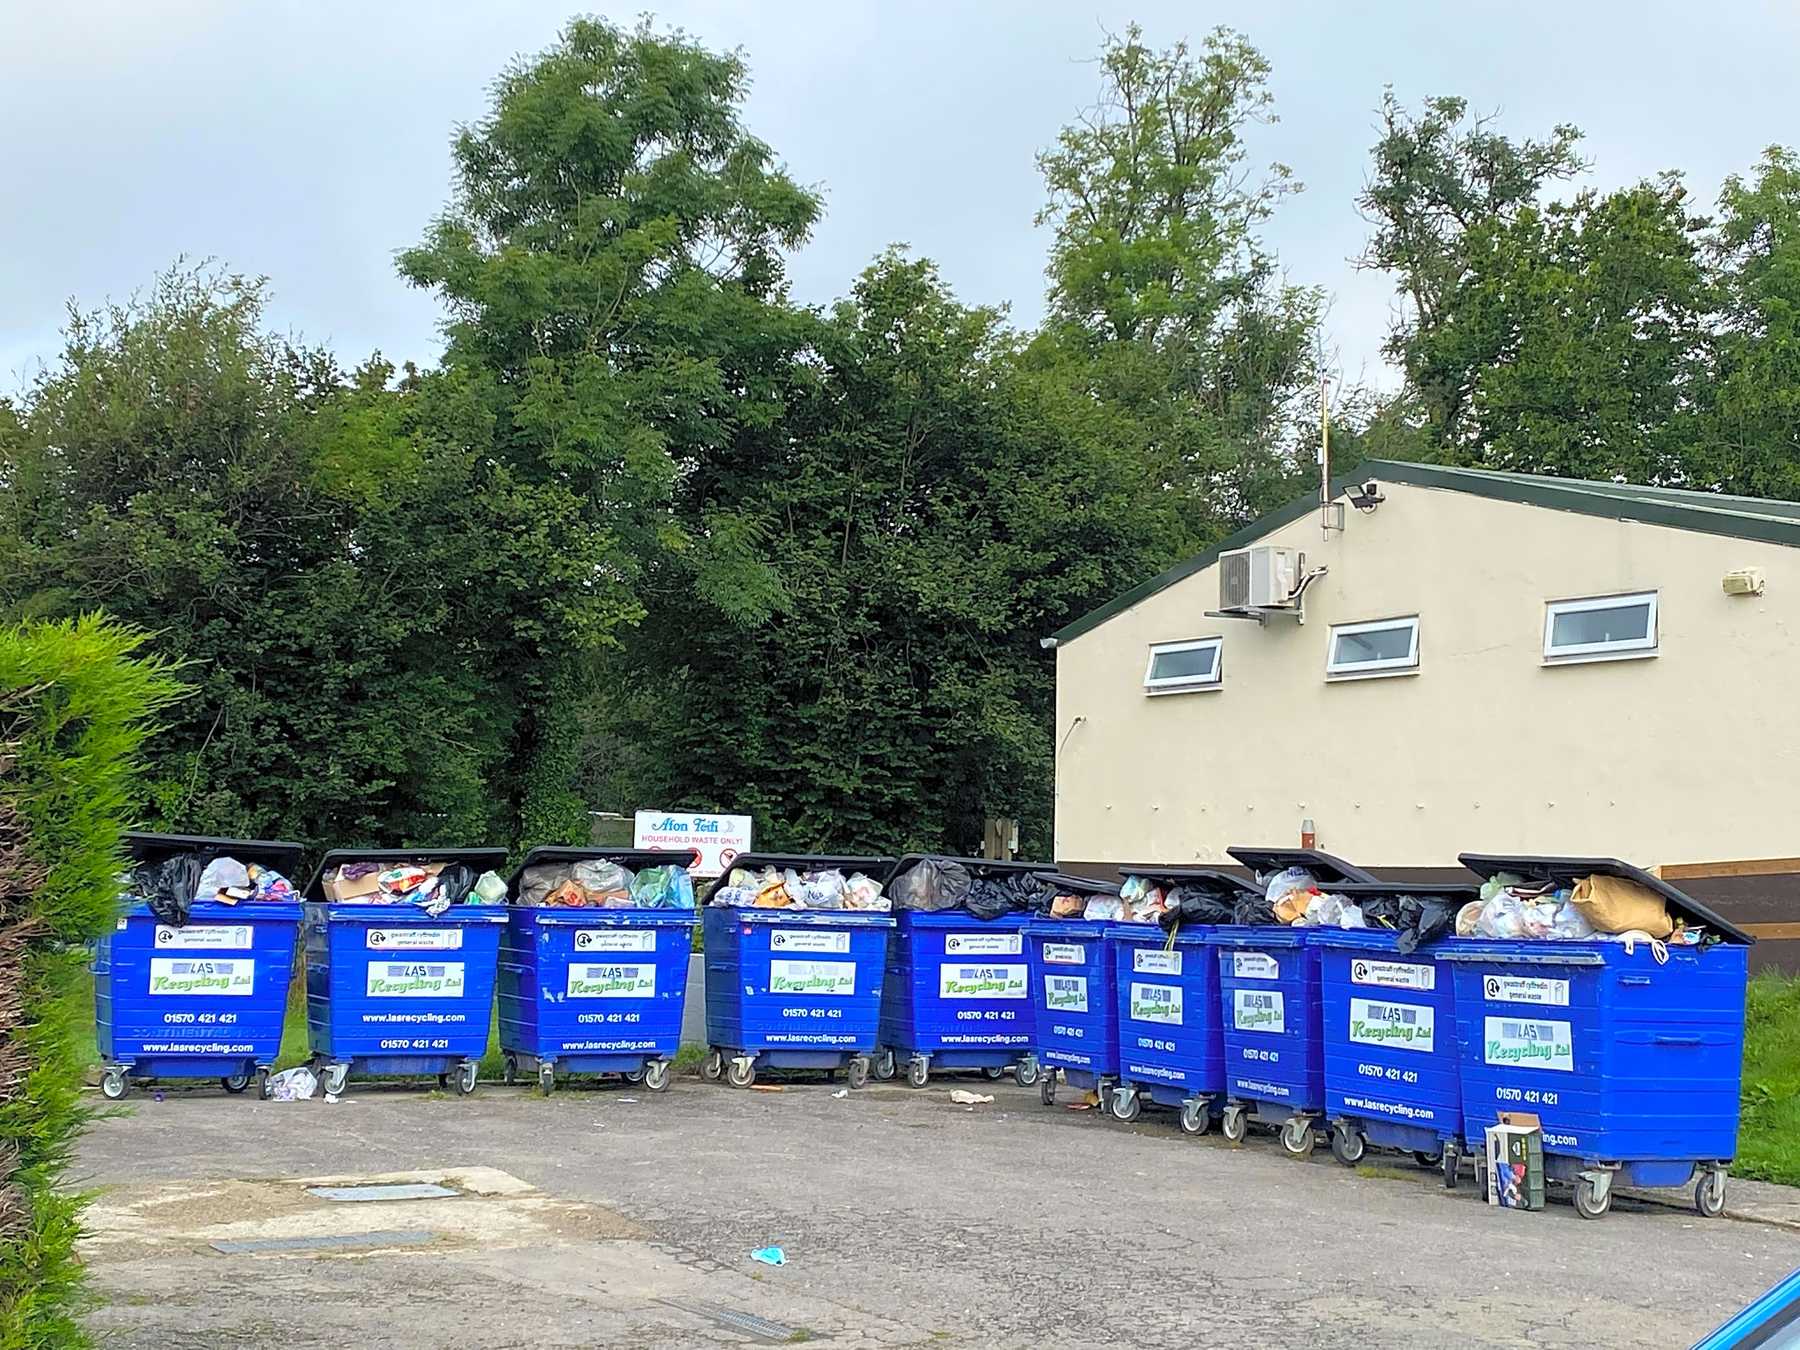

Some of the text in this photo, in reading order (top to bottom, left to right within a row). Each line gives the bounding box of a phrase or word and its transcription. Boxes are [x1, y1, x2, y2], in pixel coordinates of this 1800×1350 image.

[651, 817, 718, 833] Afon Teifi
[642, 835, 743, 845] HOUSEHOLD WASTE ONLY!
[190, 963, 214, 973] LAS
[404, 966, 427, 977] LAS
[602, 968, 622, 978] LAS
[974, 969, 993, 978] LAS
[153, 976, 250, 991] Recycling Ltd
[370, 978, 461, 993] Recycling Ltd
[570, 979, 653, 994] Recycling Ltd
[945, 980, 1006, 994] Recycling
[1008, 980, 1022, 988] Ltd
[164, 1014, 237, 1023] 01570 421 421
[363, 1013, 465, 1023] www.lasrecycling.com
[578, 1014, 640, 1023] 01570 421 421
[783, 1009, 842, 1018] 01570 421 421
[957, 1011, 1015, 1019] 01570 421 421
[1383, 1006, 1401, 1022] LAS
[1352, 1021, 1431, 1041] Recycling Ltd
[1518, 1023, 1537, 1040] LAS
[381, 1040, 448, 1048] 01570 421 421
[766, 1034, 856, 1044] www.lasrecycling.com
[941, 1035, 1028, 1044] www.lasrecycling.com
[143, 1043, 254, 1053] www.lasrecycling.com
[563, 1040, 655, 1050] www.lasrecycling.com
[1487, 1040, 1570, 1061] Recycling Ltd
[1358, 1064, 1418, 1082] 01570 421 421
[1496, 1088, 1558, 1104] 01570 421 421
[1344, 1096, 1434, 1119] www.lasrecycling.com
